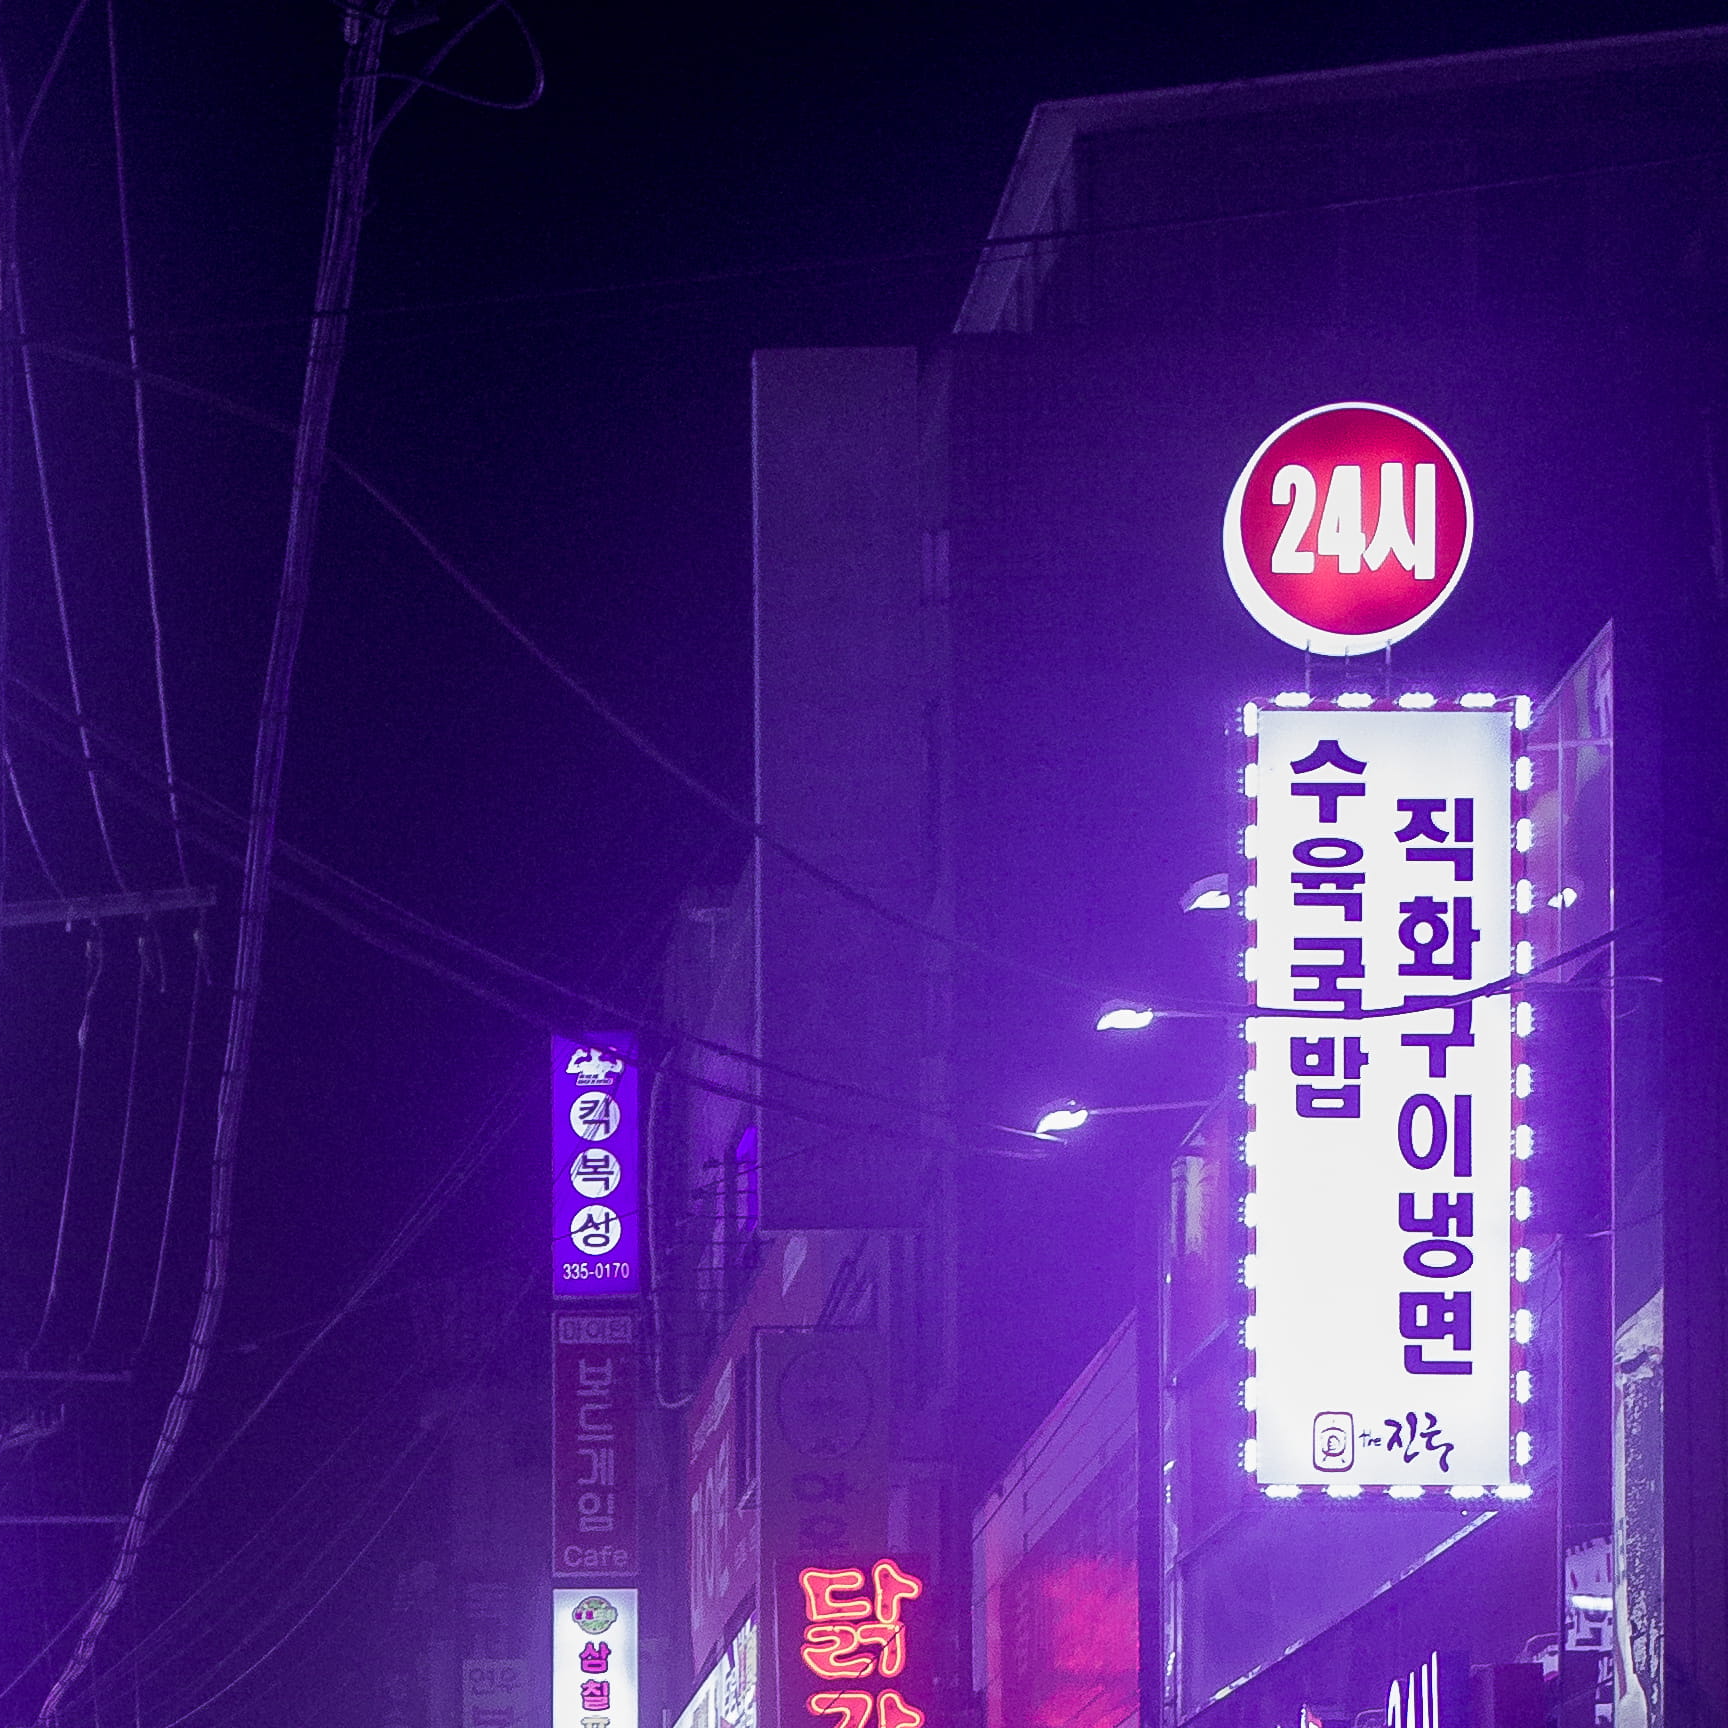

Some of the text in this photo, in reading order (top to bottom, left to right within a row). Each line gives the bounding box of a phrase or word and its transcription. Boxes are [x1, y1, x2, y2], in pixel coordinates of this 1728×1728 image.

[1272, 462, 1436, 580] 24시
[1290, 739, 1369, 1119] 수육국밥
[1395, 797, 1481, 1375] 직화구이냉면
[563, 1262, 630, 1280] 335-0170
[1384, 1411, 1454, 1473] 진국
[563, 1544, 630, 1568] Cafe
